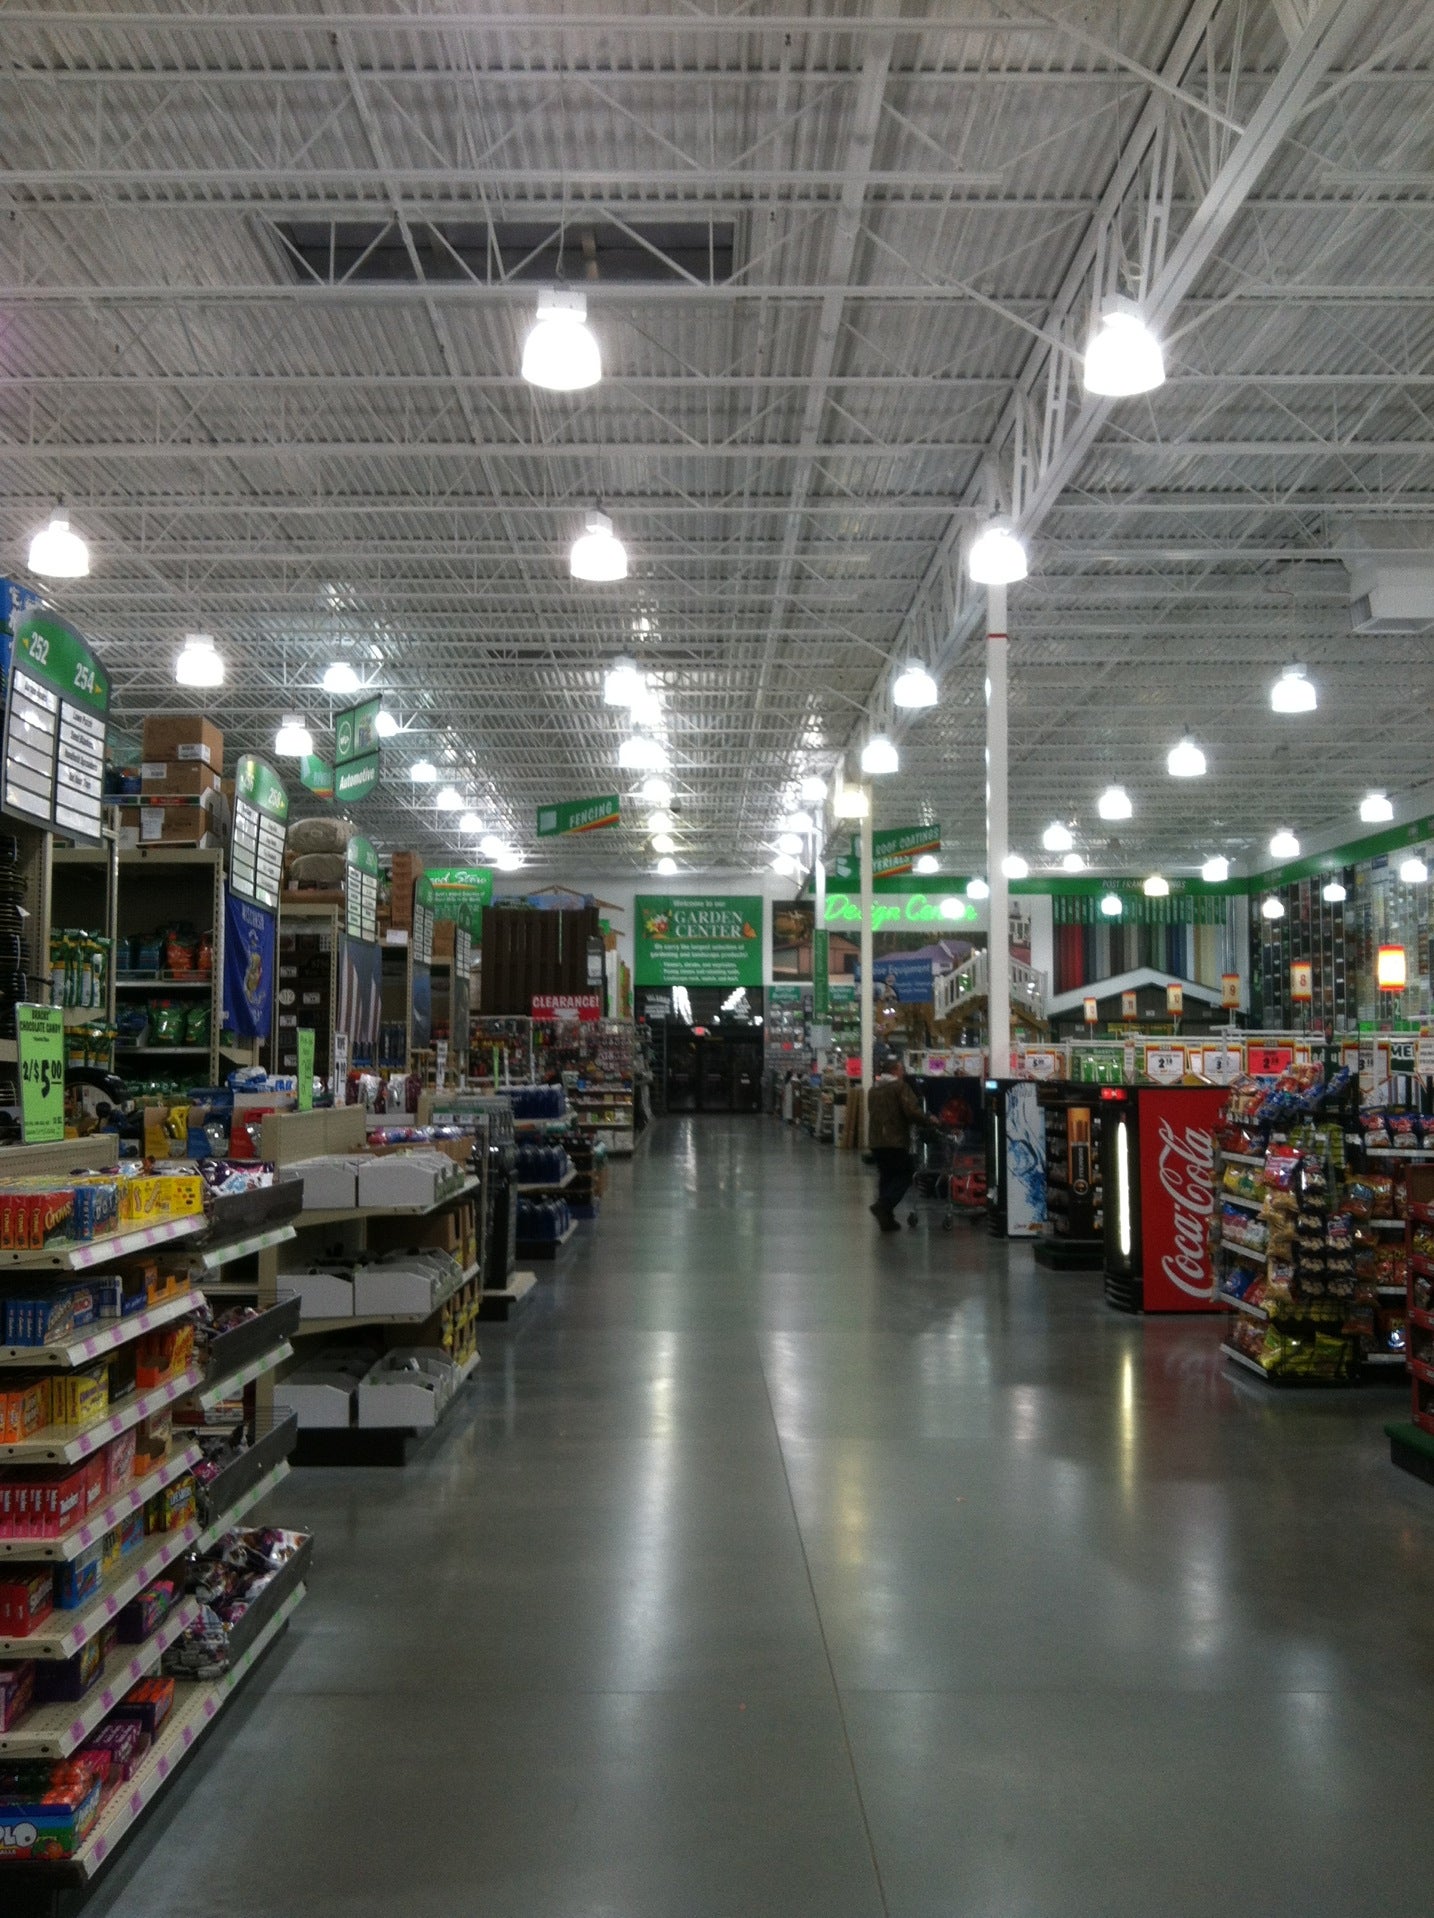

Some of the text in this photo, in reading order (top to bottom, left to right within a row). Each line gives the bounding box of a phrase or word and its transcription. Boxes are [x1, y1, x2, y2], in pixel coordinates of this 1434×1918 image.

[29, 631, 50, 665] 252
[73, 662, 96, 694] 254
[339, 767, 376, 791] Automotive
[569, 801, 613, 828] FENCING
[899, 826, 940, 849] COATINGS
[673, 911, 744, 924] GARDEN
[675, 924, 742, 938] CENTER
[532, 994, 599, 1008] CLEARANCE!
[19, 1020, 61, 1034] CHOCOLATE CANDY
